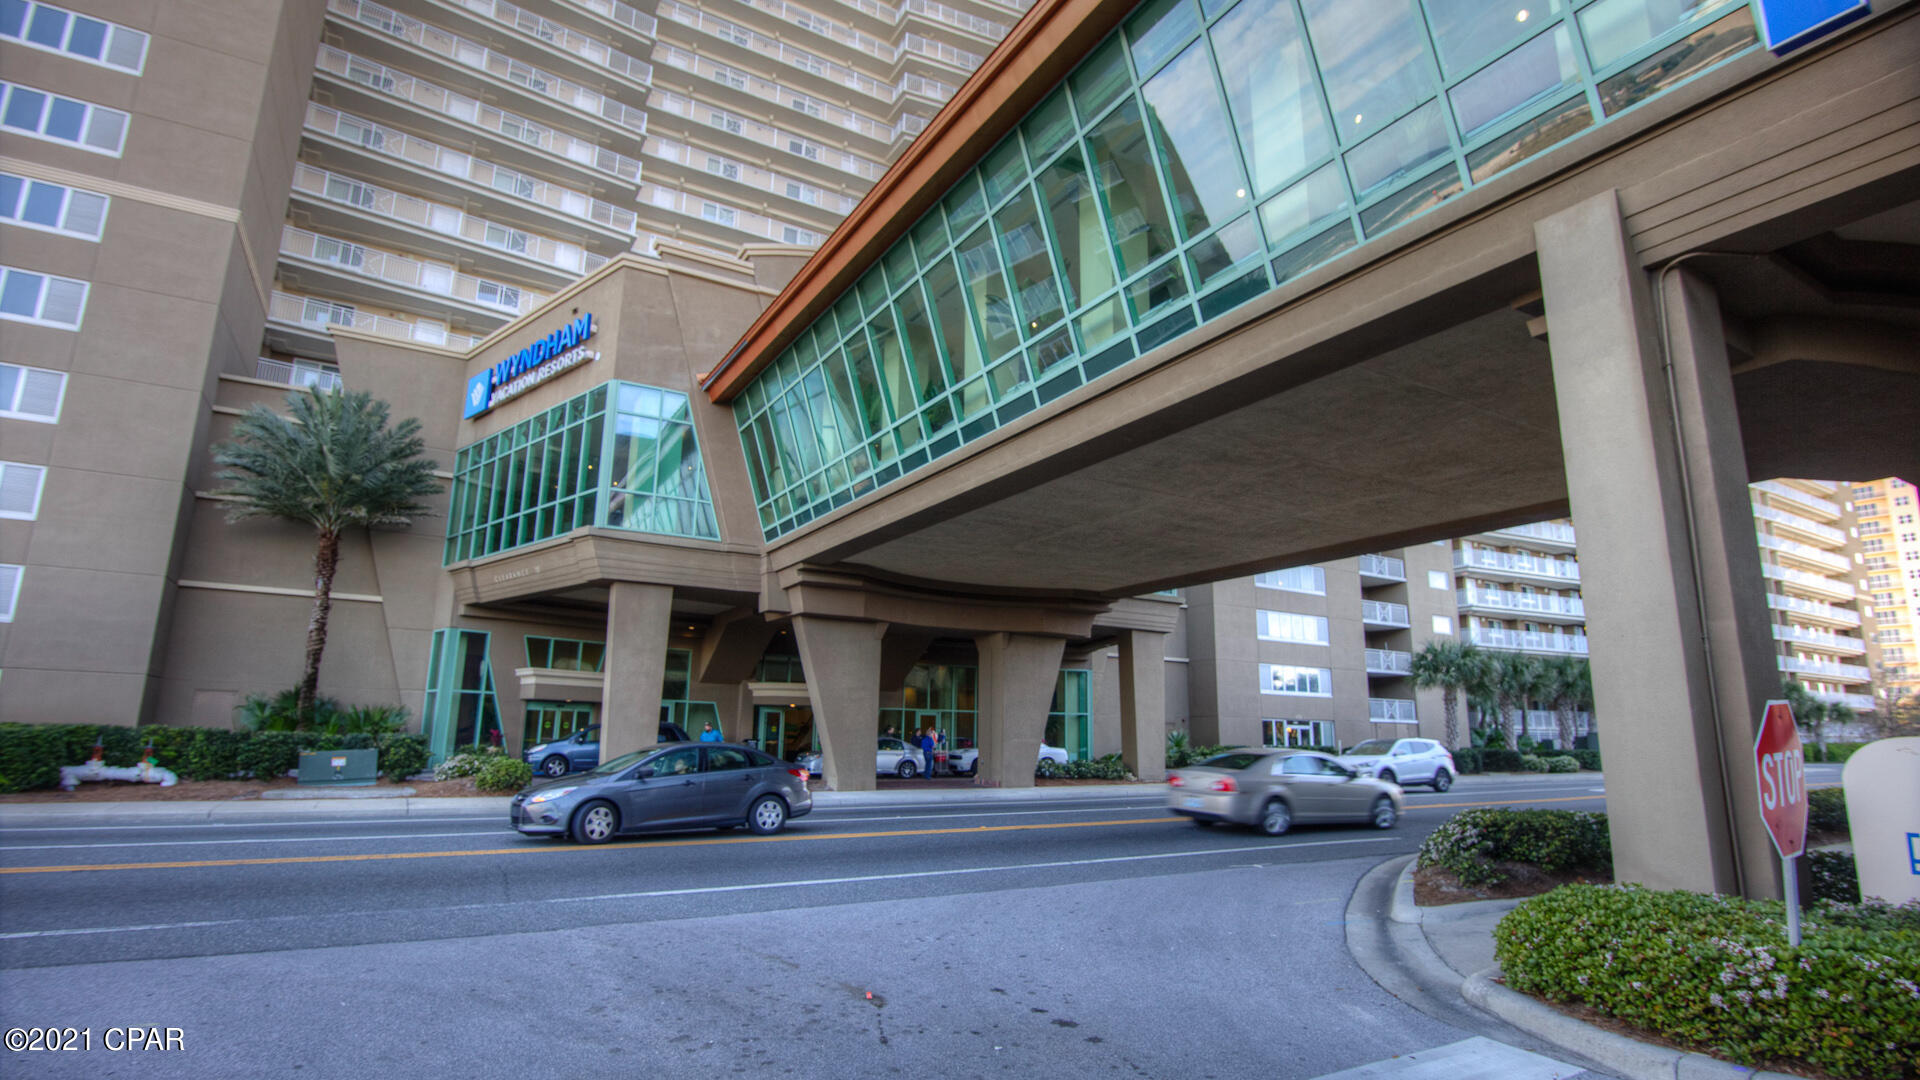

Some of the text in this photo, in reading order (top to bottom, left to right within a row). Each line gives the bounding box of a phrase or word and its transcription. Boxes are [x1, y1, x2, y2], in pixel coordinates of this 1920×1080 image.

[490, 346, 587, 406] VACATION RESORTS
[495, 312, 592, 386] WYNDHAM
[1762, 750, 1803, 810] STOP
